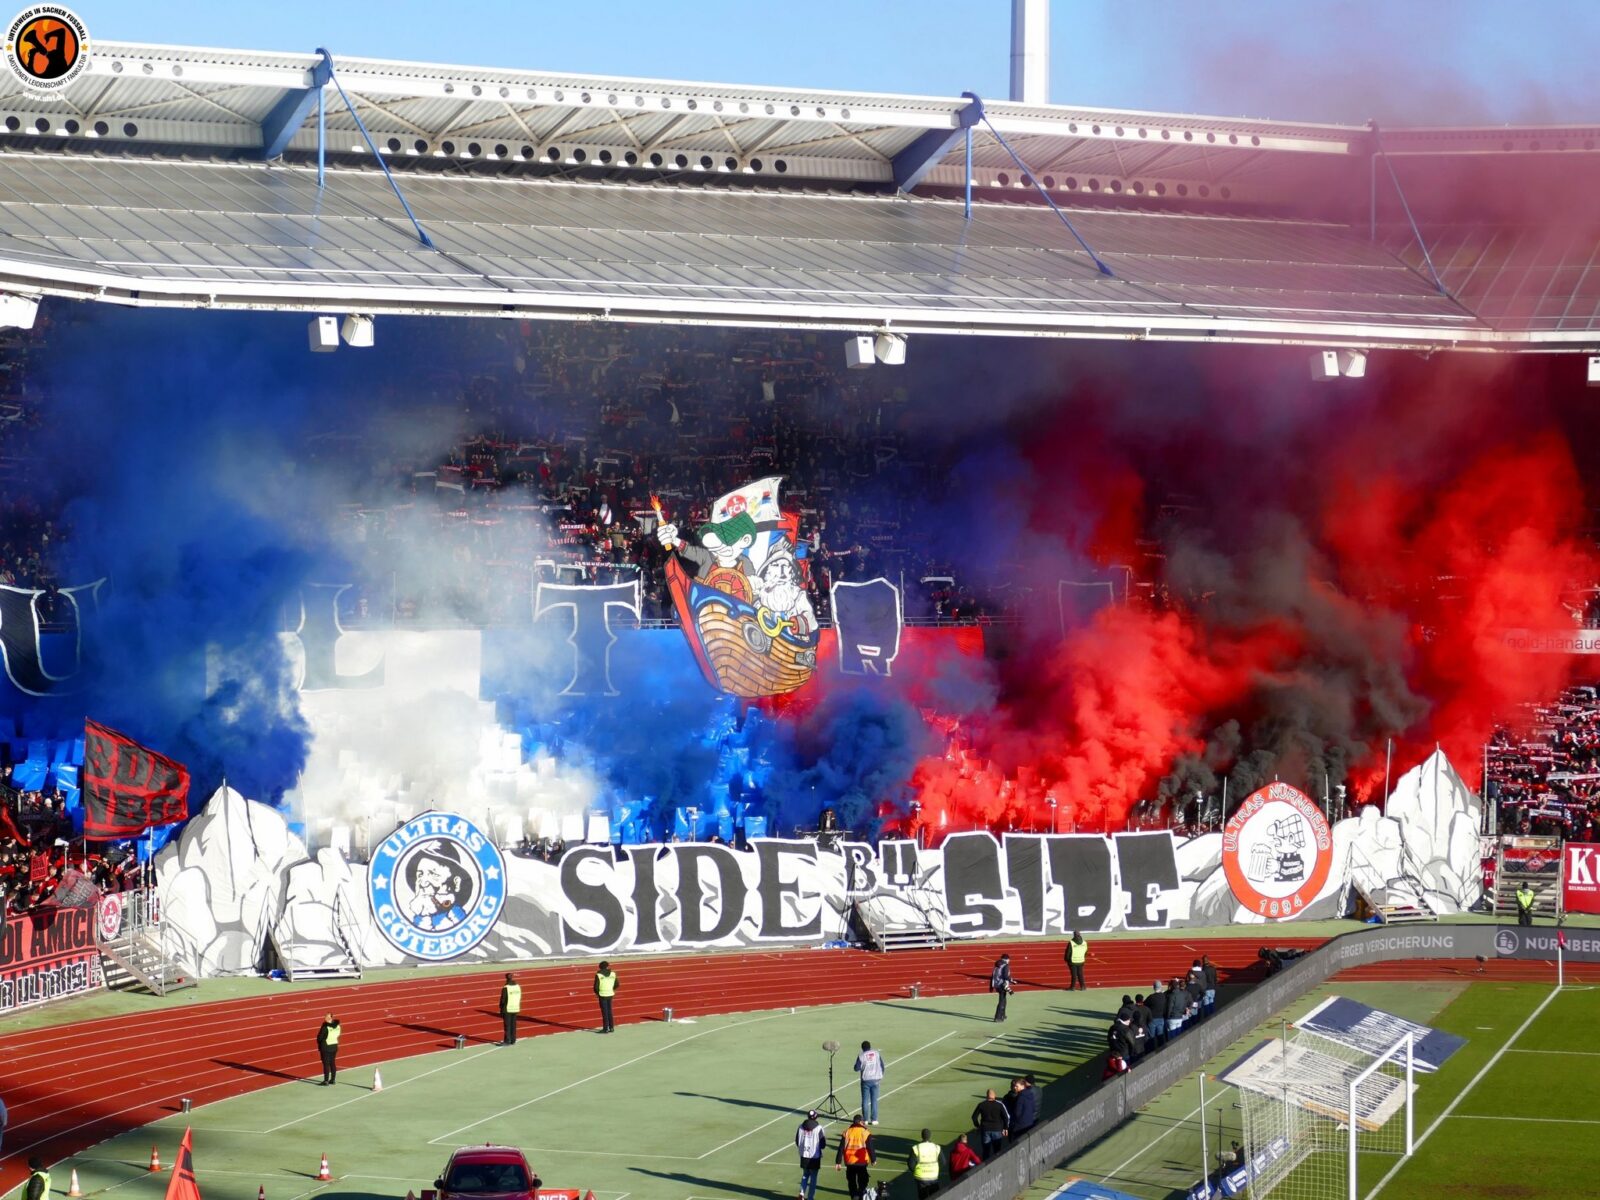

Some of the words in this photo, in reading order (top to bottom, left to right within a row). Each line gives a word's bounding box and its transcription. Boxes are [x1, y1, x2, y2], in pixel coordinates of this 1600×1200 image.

[381, 815, 486, 858] ULTRAS
[1224, 793, 1265, 852] ULTRAS
[558, 838, 824, 953] SIDE
[941, 831, 1179, 935] SIDE
[1259, 894, 1303, 916] 1994
[31, 907, 95, 958] AMICI
[1366, 935, 1454, 953] VERSICHERUNG
[17, 961, 88, 1004] ULTRAS!
